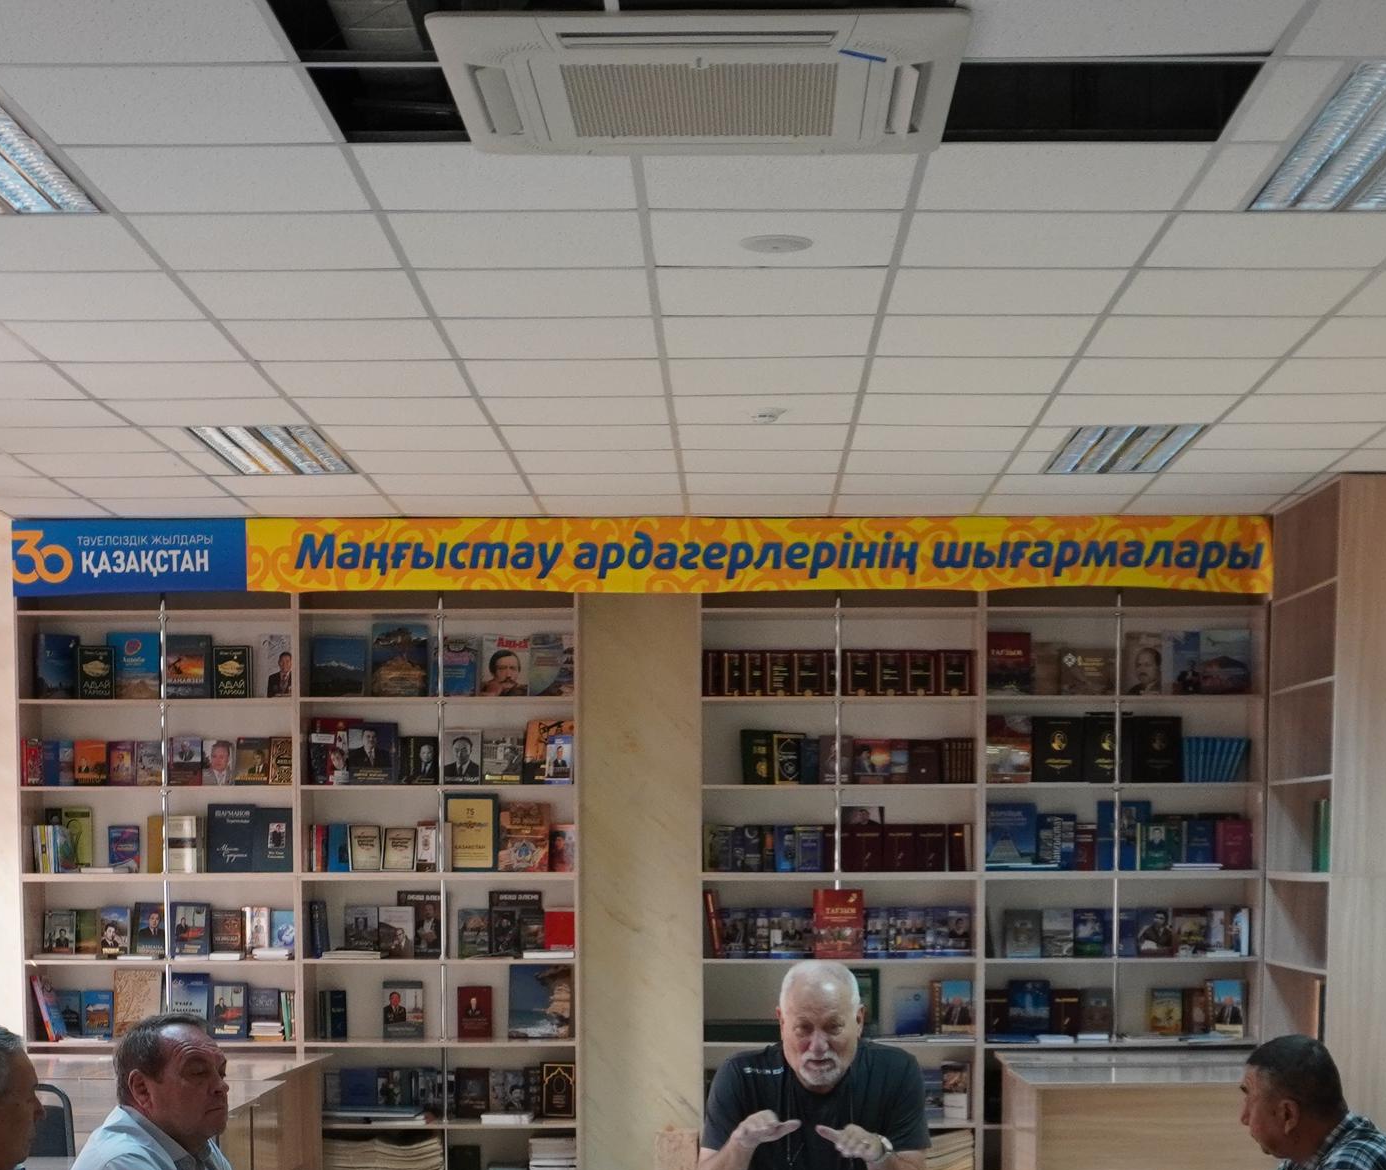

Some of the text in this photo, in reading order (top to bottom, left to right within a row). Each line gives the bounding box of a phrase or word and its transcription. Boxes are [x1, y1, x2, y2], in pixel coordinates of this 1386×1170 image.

[12, 529, 74, 584] 30
[151, 533, 214, 546] ЖЫЛДАРЫ
[293, 531, 1265, 580] Маңғыстау ардагерлерінің шығармалары
[81, 549, 210, 578] ҚАЗАҚСТАН
